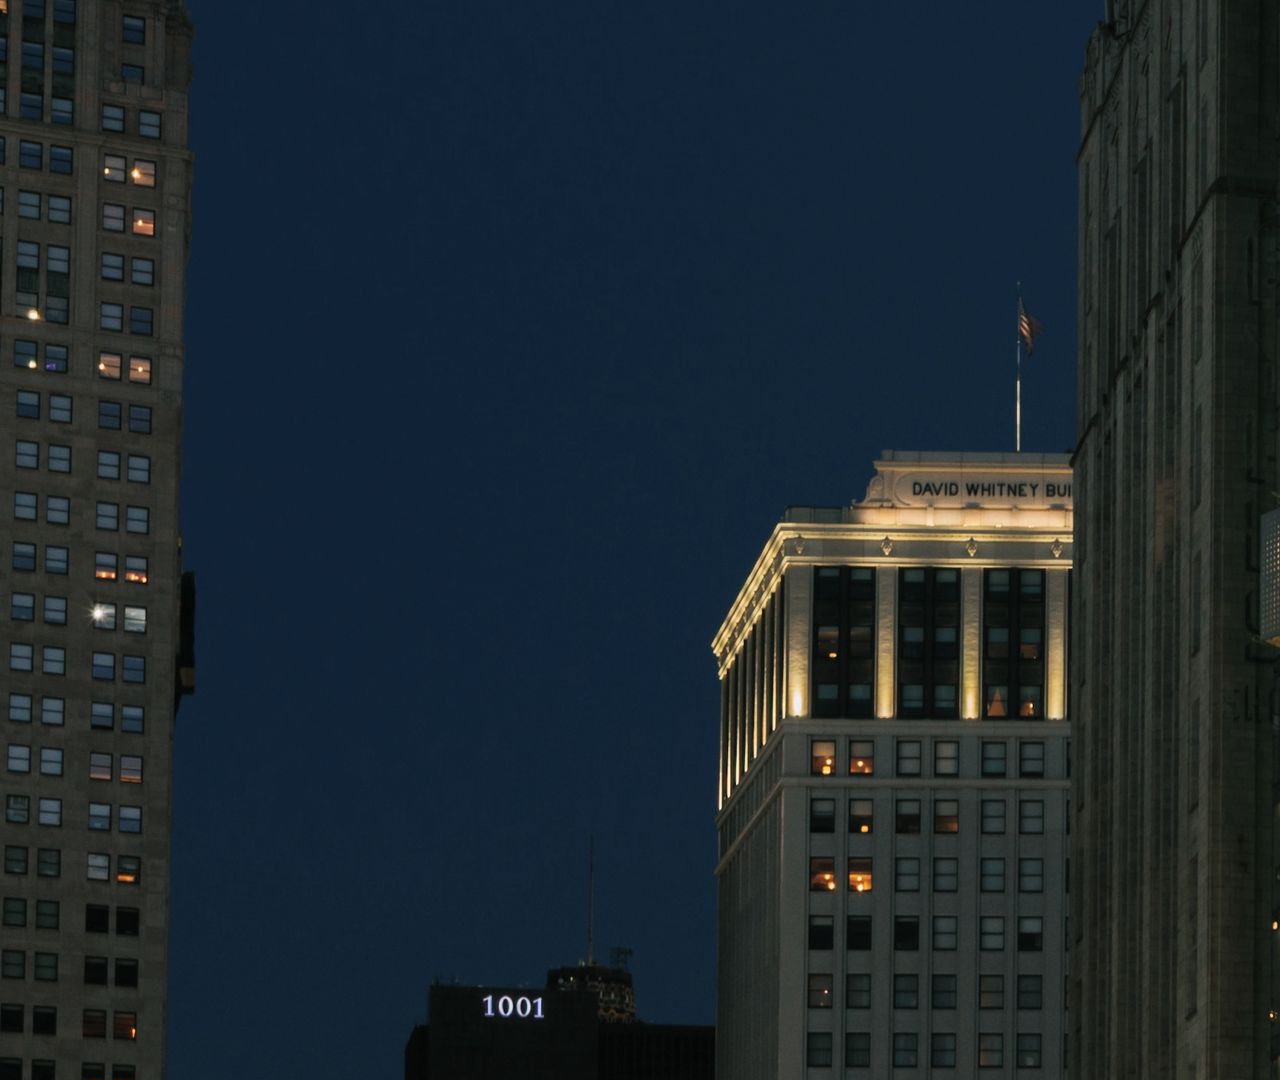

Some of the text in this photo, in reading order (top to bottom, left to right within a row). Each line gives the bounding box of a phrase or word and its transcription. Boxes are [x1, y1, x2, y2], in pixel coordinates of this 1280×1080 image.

[912, 482, 1072, 498] DAVID WHITNEY BUI
[482, 994, 545, 1019] 1001
